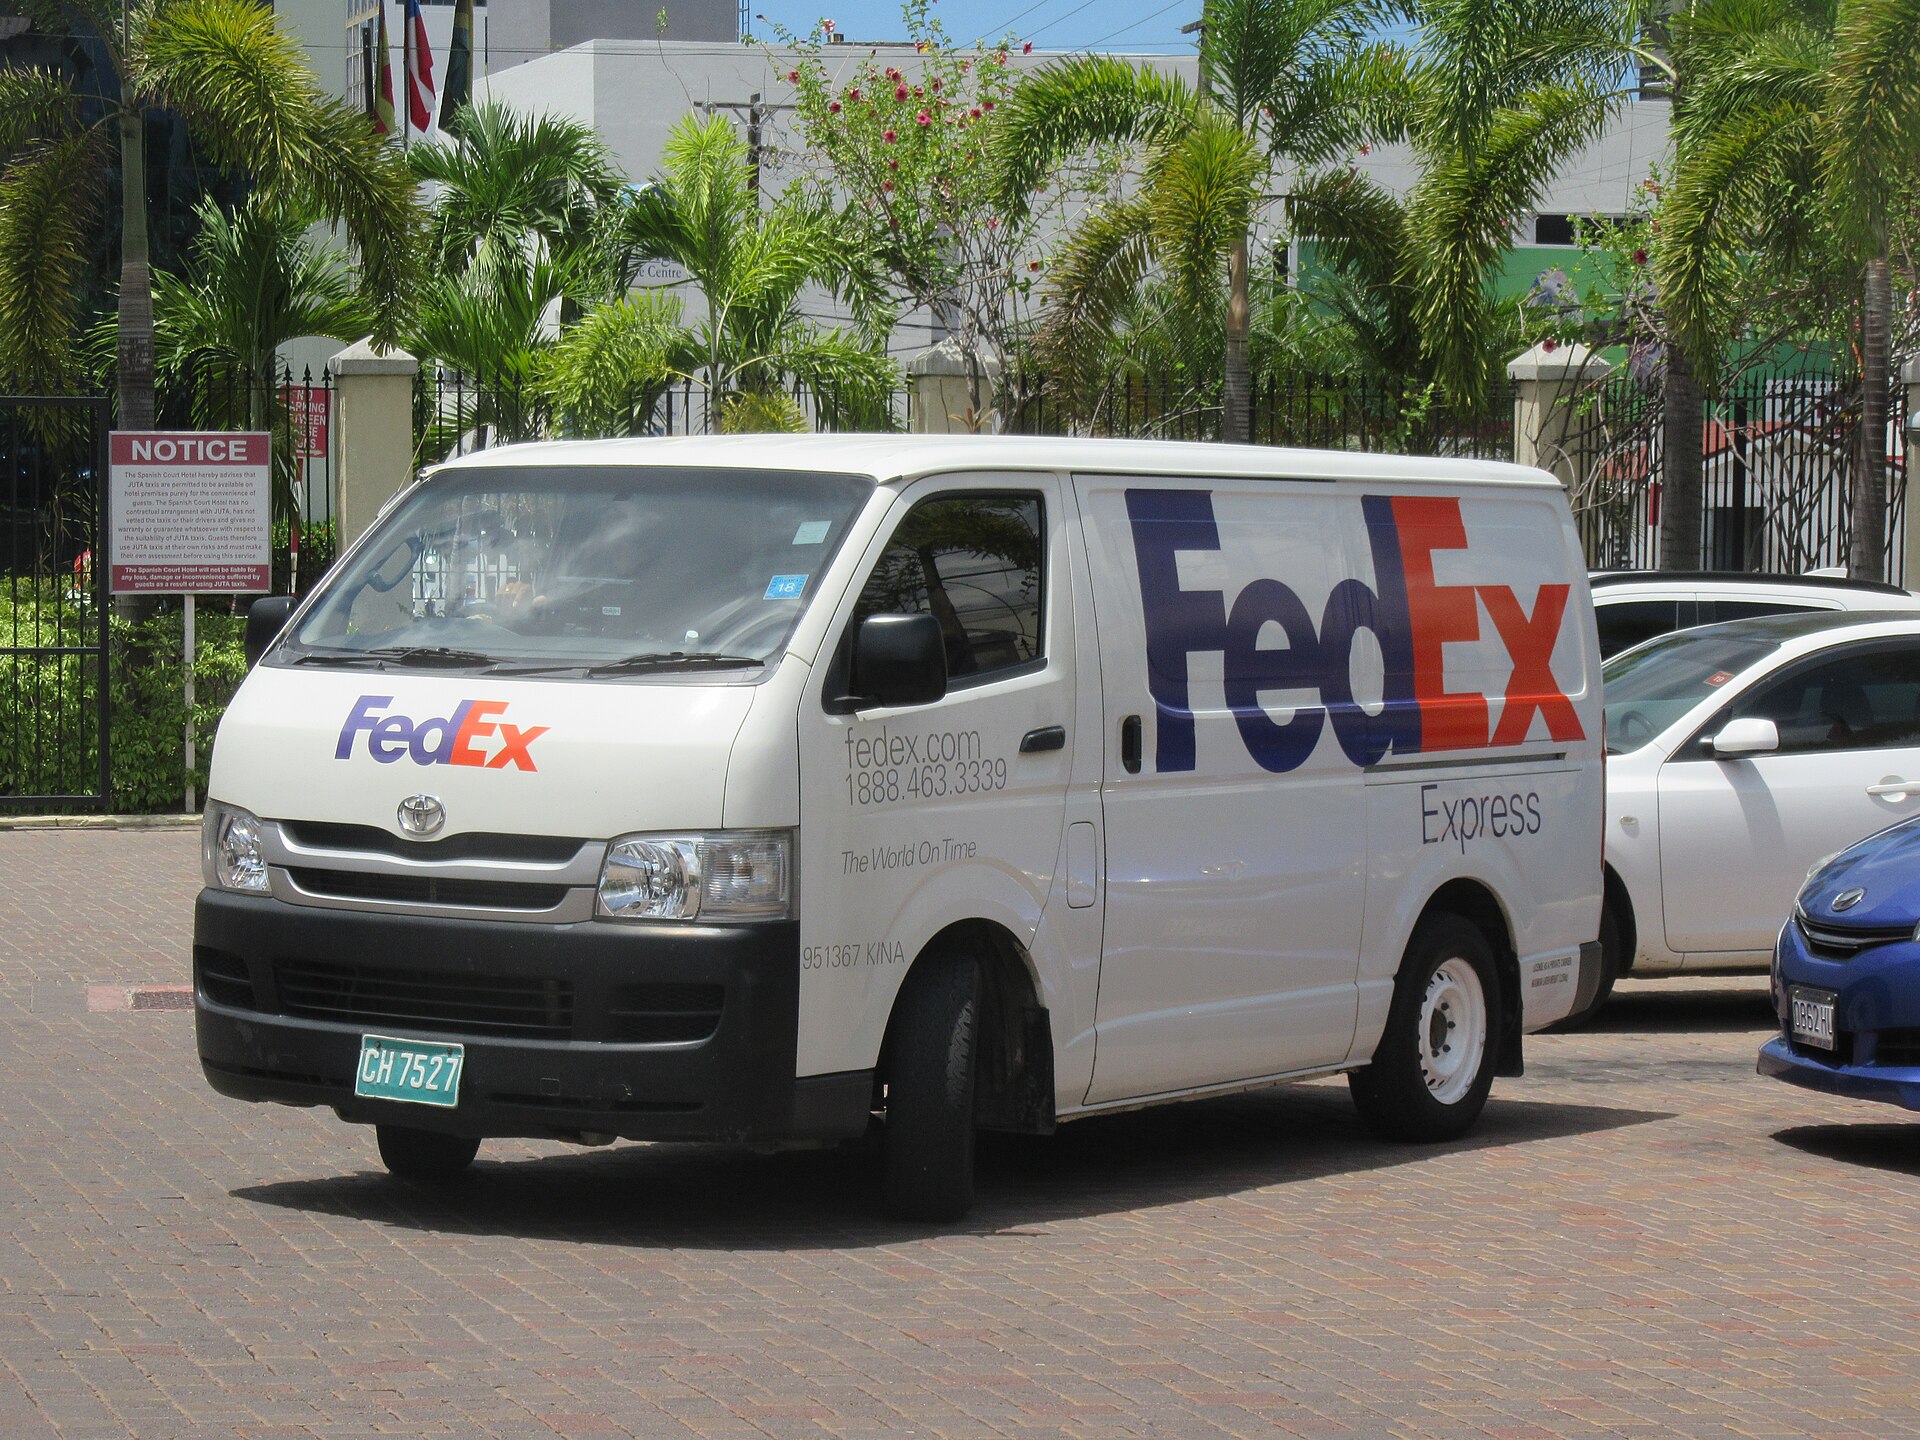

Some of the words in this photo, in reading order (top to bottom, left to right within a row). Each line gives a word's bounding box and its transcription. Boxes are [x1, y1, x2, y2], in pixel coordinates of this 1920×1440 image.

[648, 265, 682, 278] Centre
[131, 440, 248, 461] NOTICE
[138, 472, 162, 480] Spanish
[198, 472, 218, 480] hereby
[172, 481, 200, 489] permitted
[141, 490, 168, 498] premises
[170, 490, 188, 498] purely
[168, 499, 192, 507] Spanish
[161, 508, 198, 516] arrangement
[230, 517, 246, 525] gives
[118, 526, 144, 534] warranty
[153, 526, 182, 534] guarantee
[234, 526, 256, 534] respect
[136, 535, 164, 543] suitability
[204, 553, 220, 561] using
[778, 583, 795, 592] 18
[1124, 488, 1586, 773] FedEx
[334, 695, 551, 772] FedEx
[844, 725, 980, 769] fedex.com
[845, 757, 1006, 805] 1888.463.3339
[1421, 784, 1541, 855] Express
[842, 850, 868, 875] The
[872, 843, 915, 870] World
[919, 840, 940, 864] On
[942, 838, 976, 861] Time
[803, 944, 860, 969] 951367
[866, 941, 904, 965] KINA
[362, 1048, 395, 1084] CH
[398, 1052, 459, 1092] 7527
